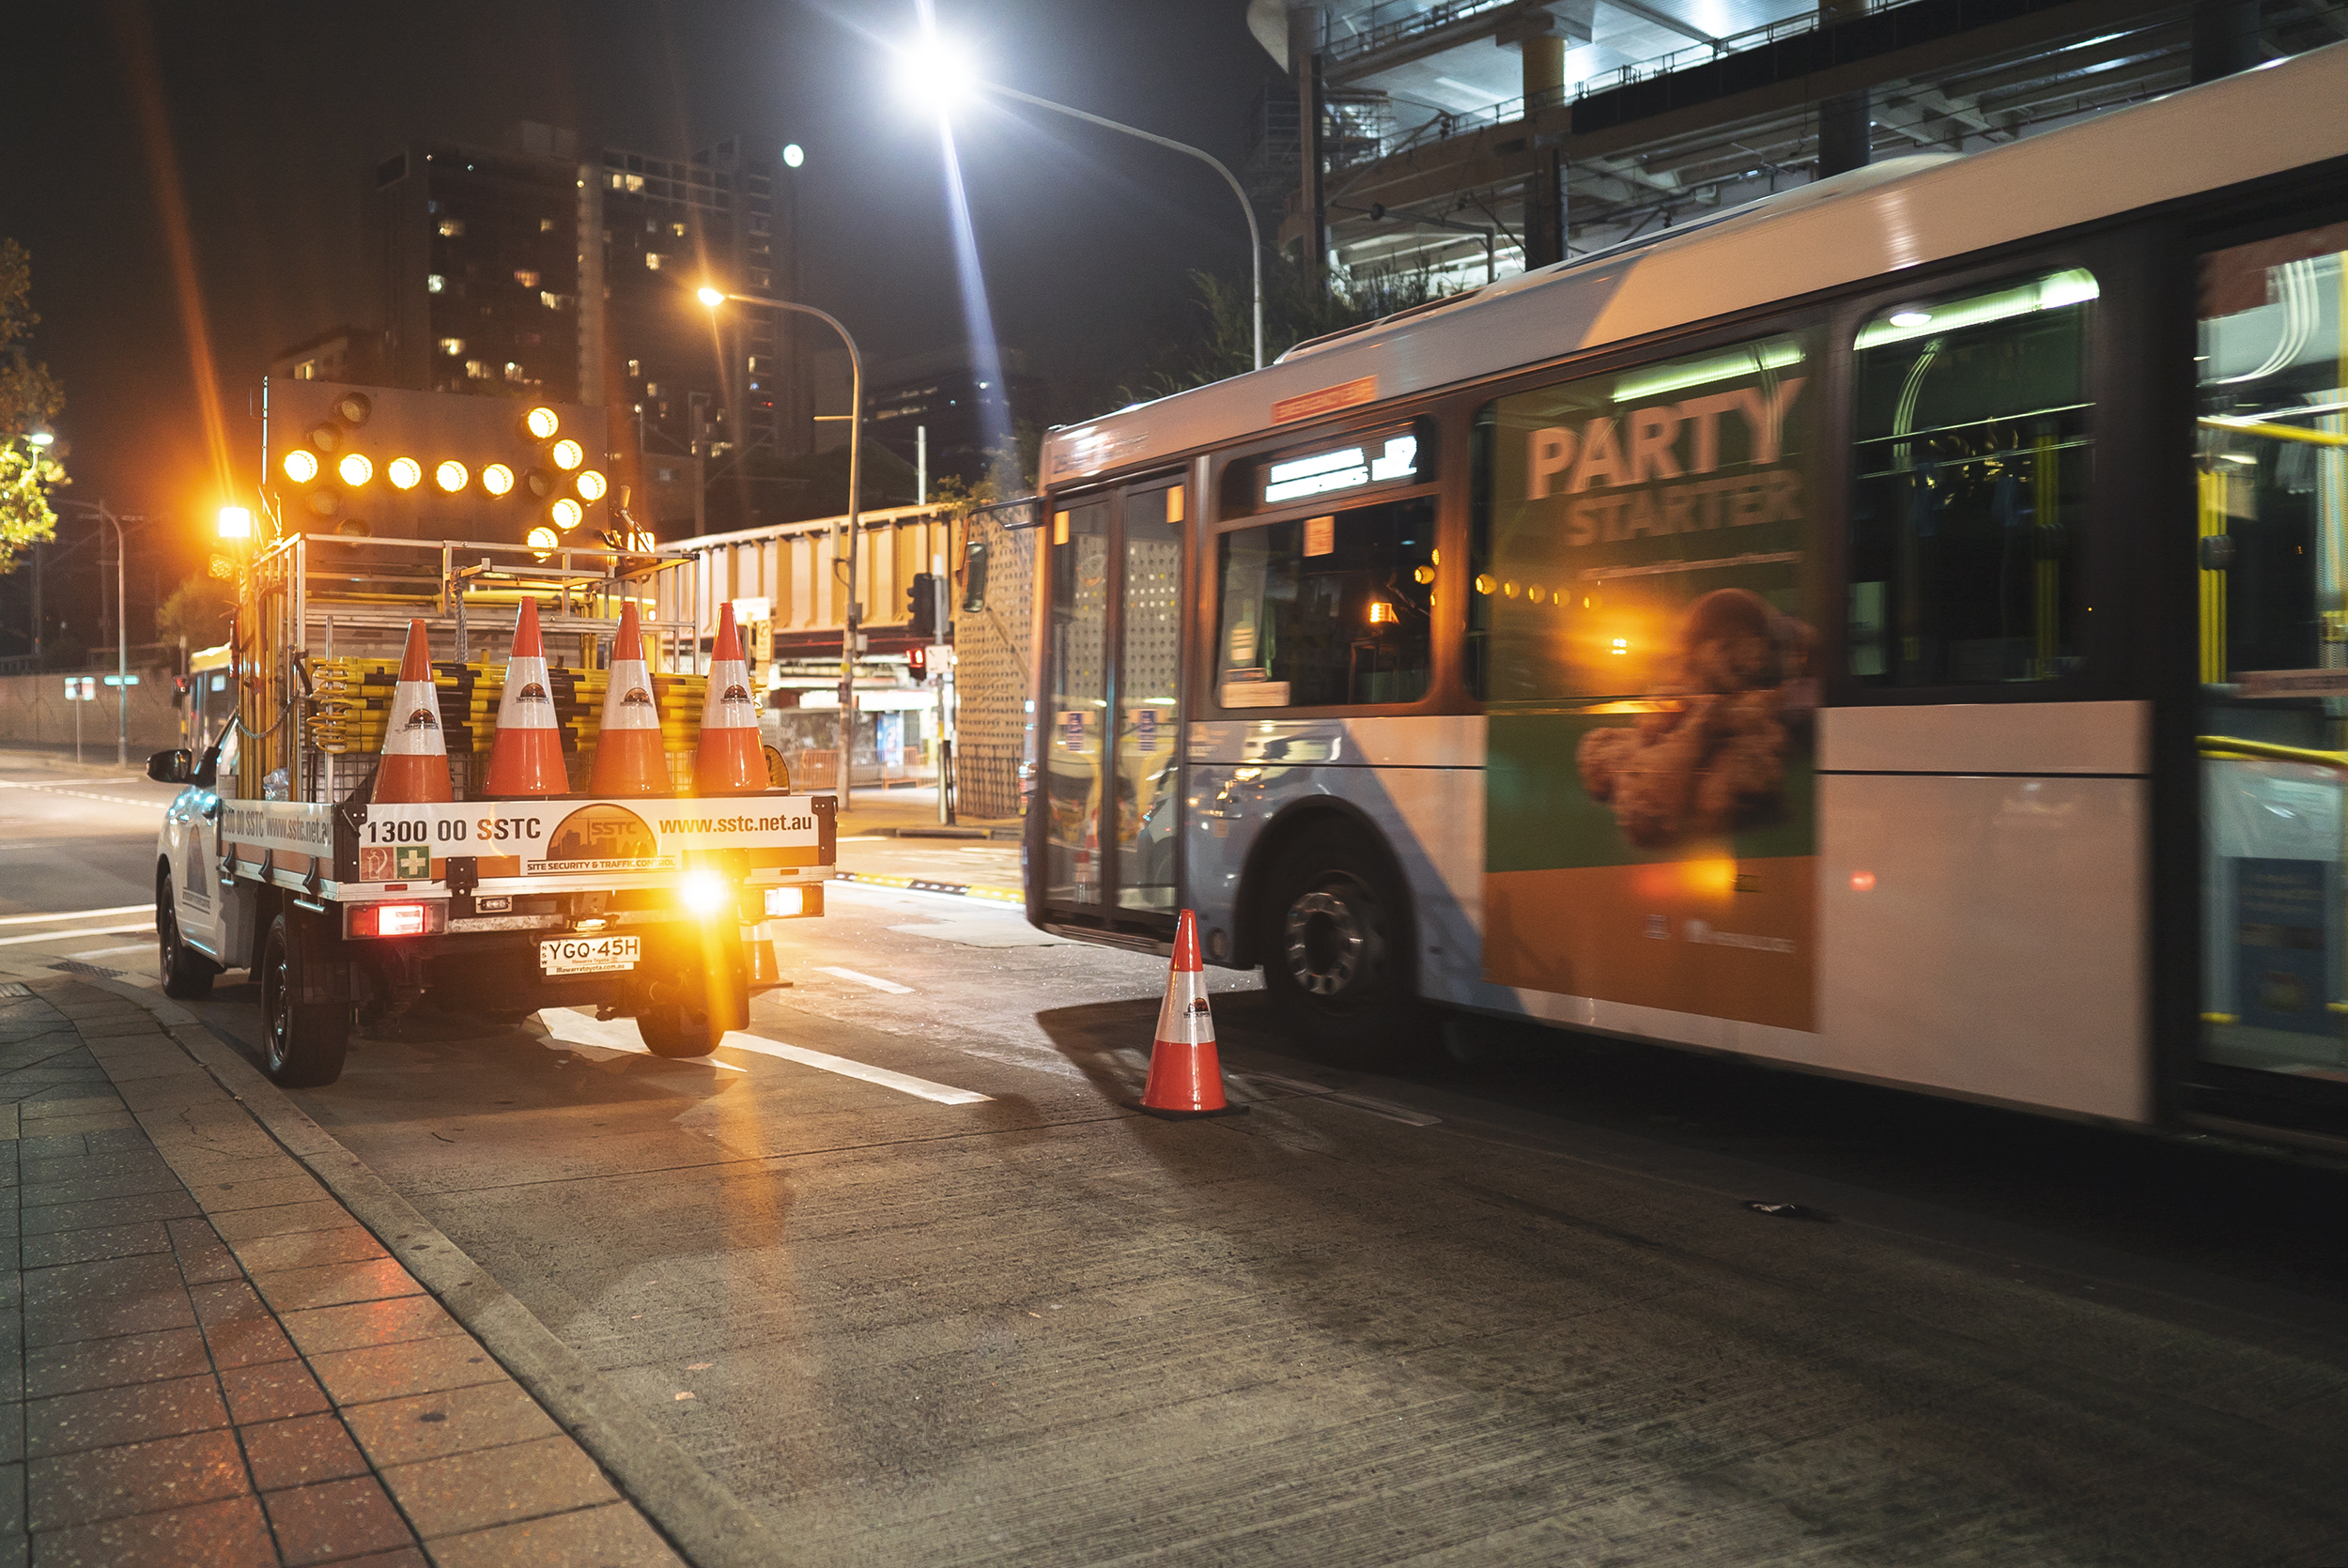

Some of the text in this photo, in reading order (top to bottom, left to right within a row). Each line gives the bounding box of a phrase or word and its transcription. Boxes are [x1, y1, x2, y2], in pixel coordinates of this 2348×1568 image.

[1526, 377, 1807, 501] PARTY
[1564, 469, 1804, 546] STARTER
[246, 810, 263, 838] SSTC
[367, 818, 541, 843] 1300 00 SSTC
[591, 822, 637, 836] SSTC
[659, 815, 811, 834] www.sstc.net.au
[527, 863, 547, 871] SITE
[548, 861, 590, 870] SECURITY
[592, 860, 598, 869] &
[599, 859, 635, 868] TRAFFIC
